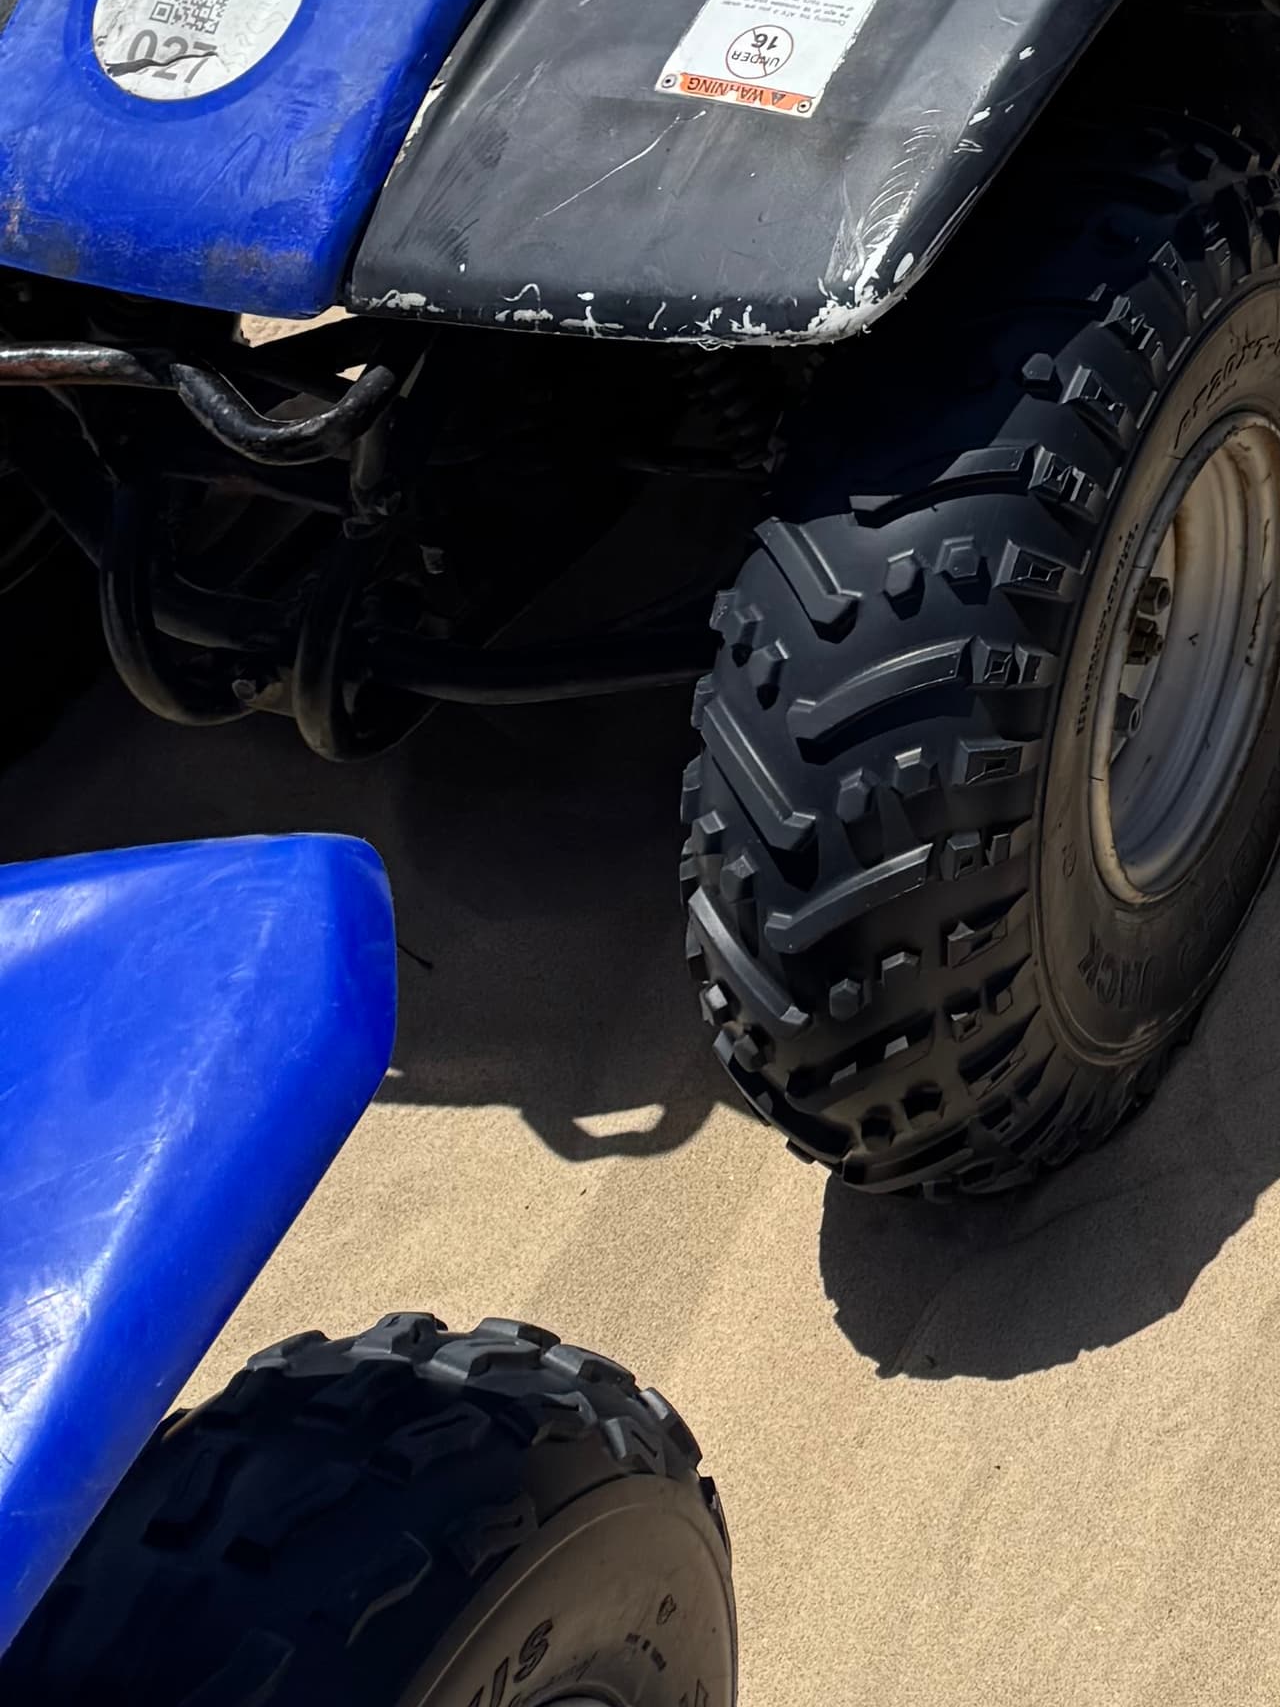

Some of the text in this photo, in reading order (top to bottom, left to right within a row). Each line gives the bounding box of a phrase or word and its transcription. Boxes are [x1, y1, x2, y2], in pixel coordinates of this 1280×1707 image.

[751, 33, 779, 51] 16
[127, 29, 218, 84] 027
[730, 49, 781, 69] UNDER
[687, 77, 764, 103] WARNING
